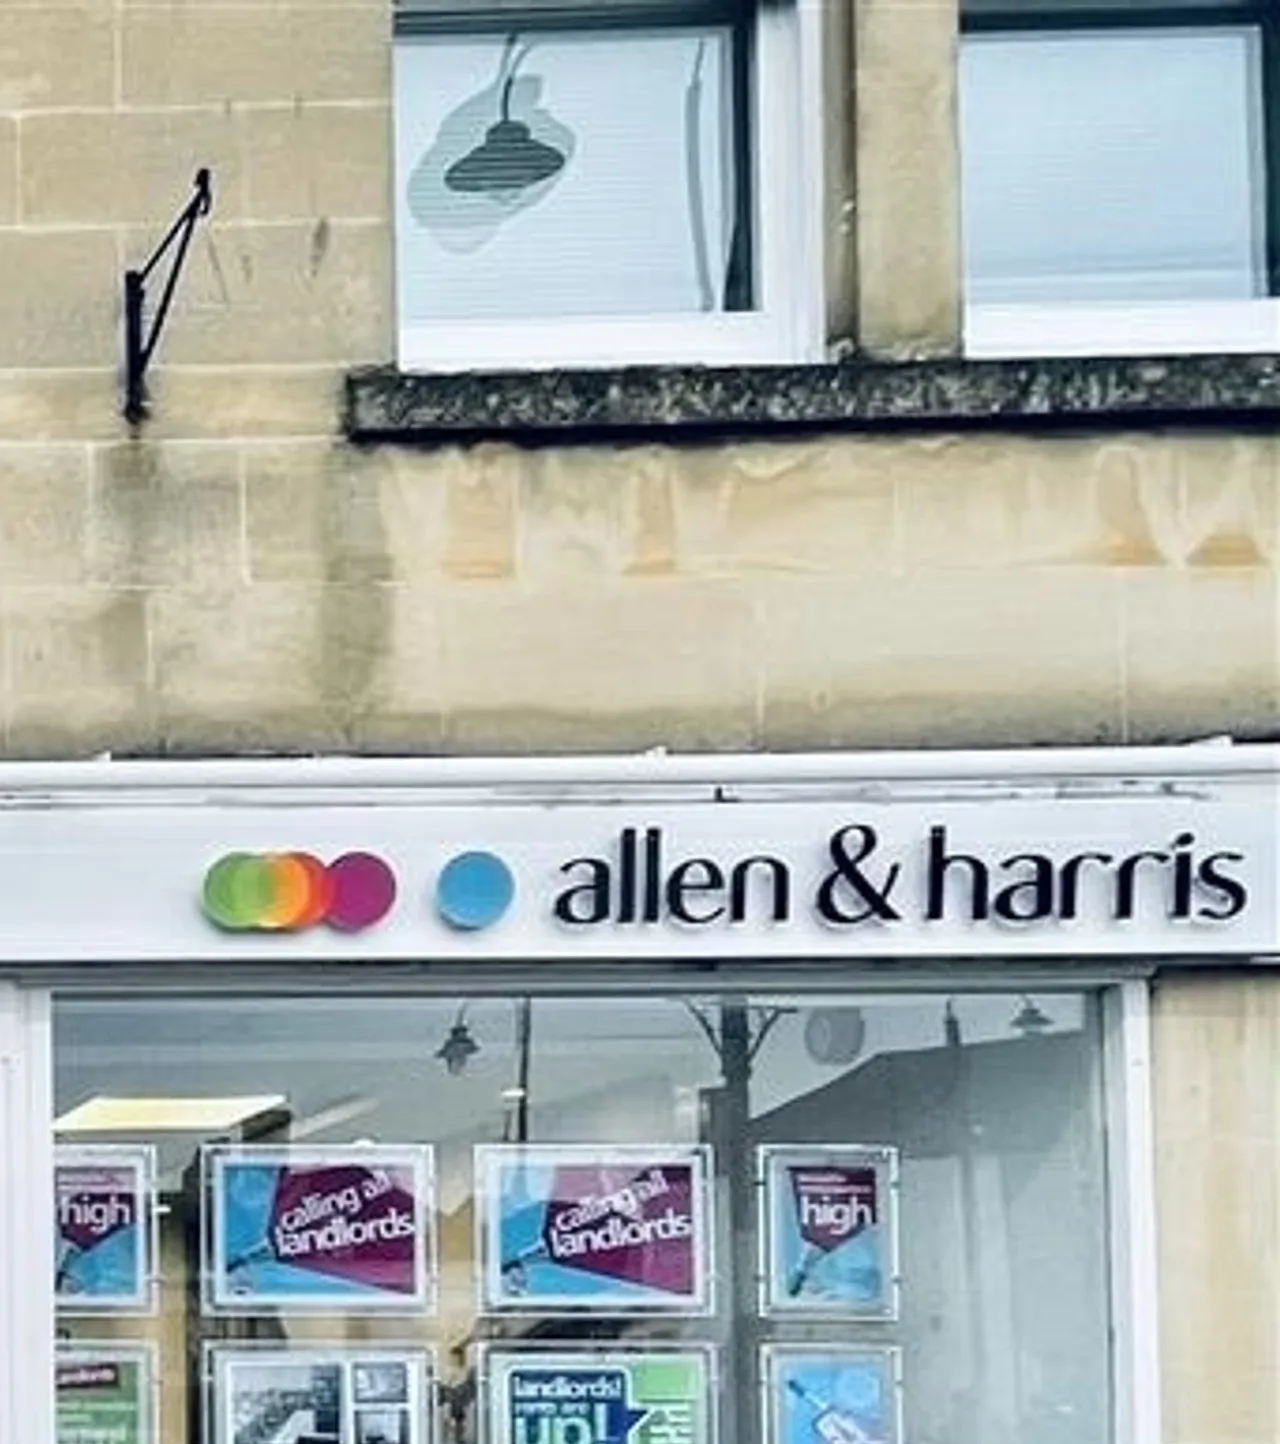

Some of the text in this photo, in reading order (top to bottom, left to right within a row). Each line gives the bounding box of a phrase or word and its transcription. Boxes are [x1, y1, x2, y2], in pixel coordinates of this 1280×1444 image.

[554, 823, 1247, 924] allen & harris
[61, 1196, 130, 1234] high
[280, 1183, 363, 1230] calling
[554, 1188, 638, 1233] calling
[801, 1195, 872, 1235] high
[274, 1208, 415, 1258] landlords
[550, 1209, 692, 1260] landlords
